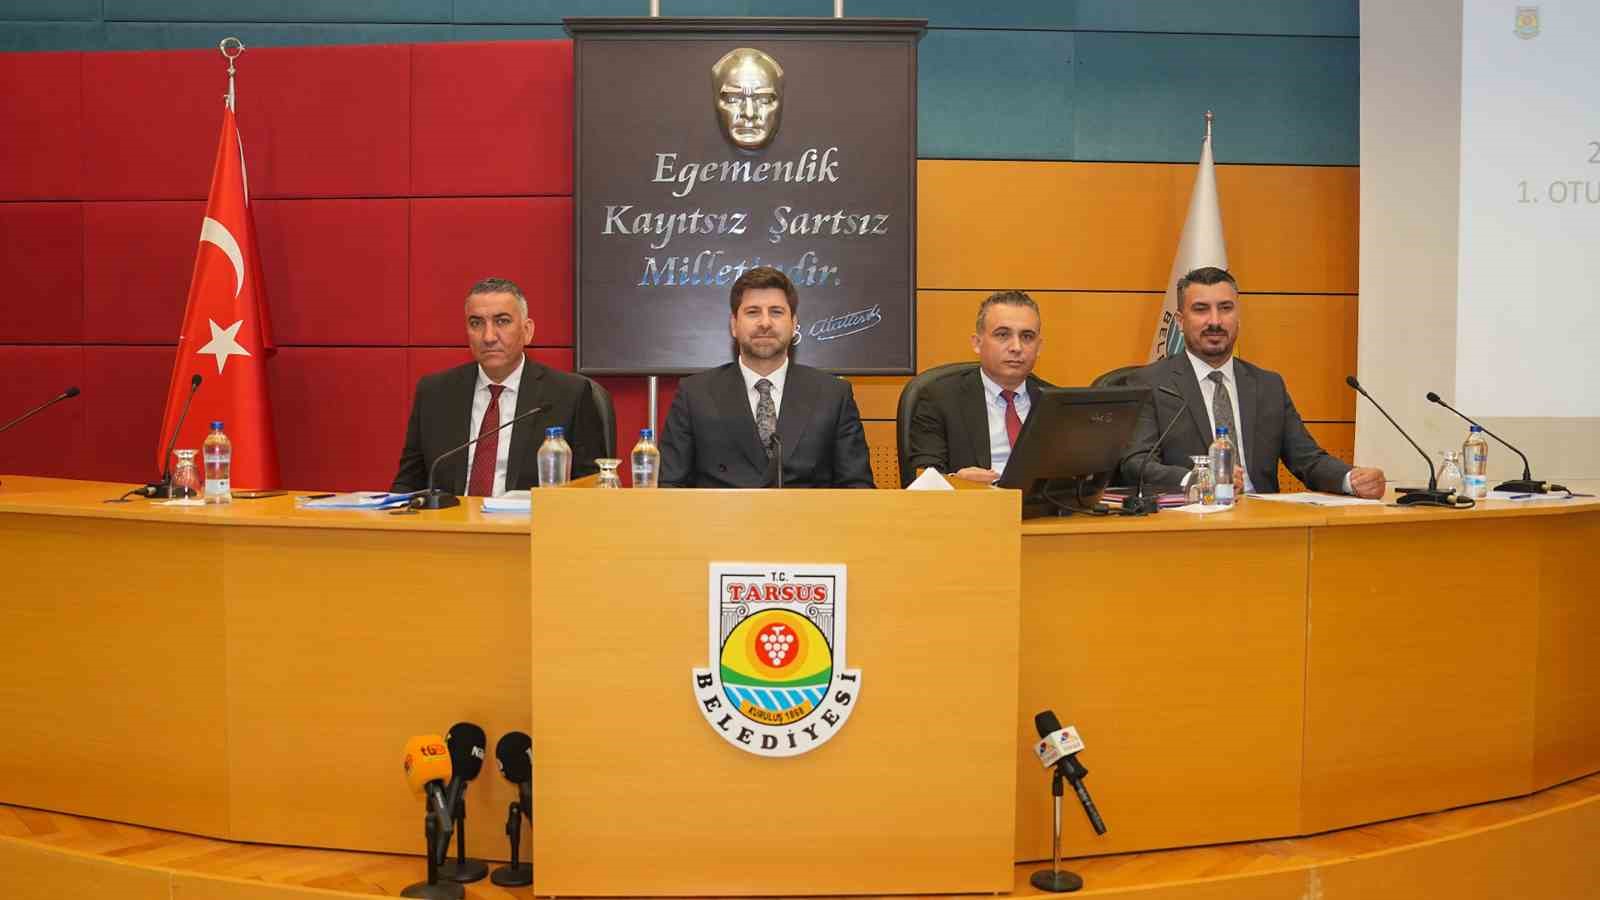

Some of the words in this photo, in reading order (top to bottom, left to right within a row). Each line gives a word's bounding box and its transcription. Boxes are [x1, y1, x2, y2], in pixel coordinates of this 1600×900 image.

[652, 147, 839, 197] Egemenlik
[1517, 181, 1539, 204] 1.
[602, 205, 749, 249] Kayıtsız
[769, 206, 889, 243] Şartsız
[727, 583, 828, 603] TARSUS
[771, 572, 789, 582] T.C.
[697, 672, 857, 750] BELEDİYESİ
